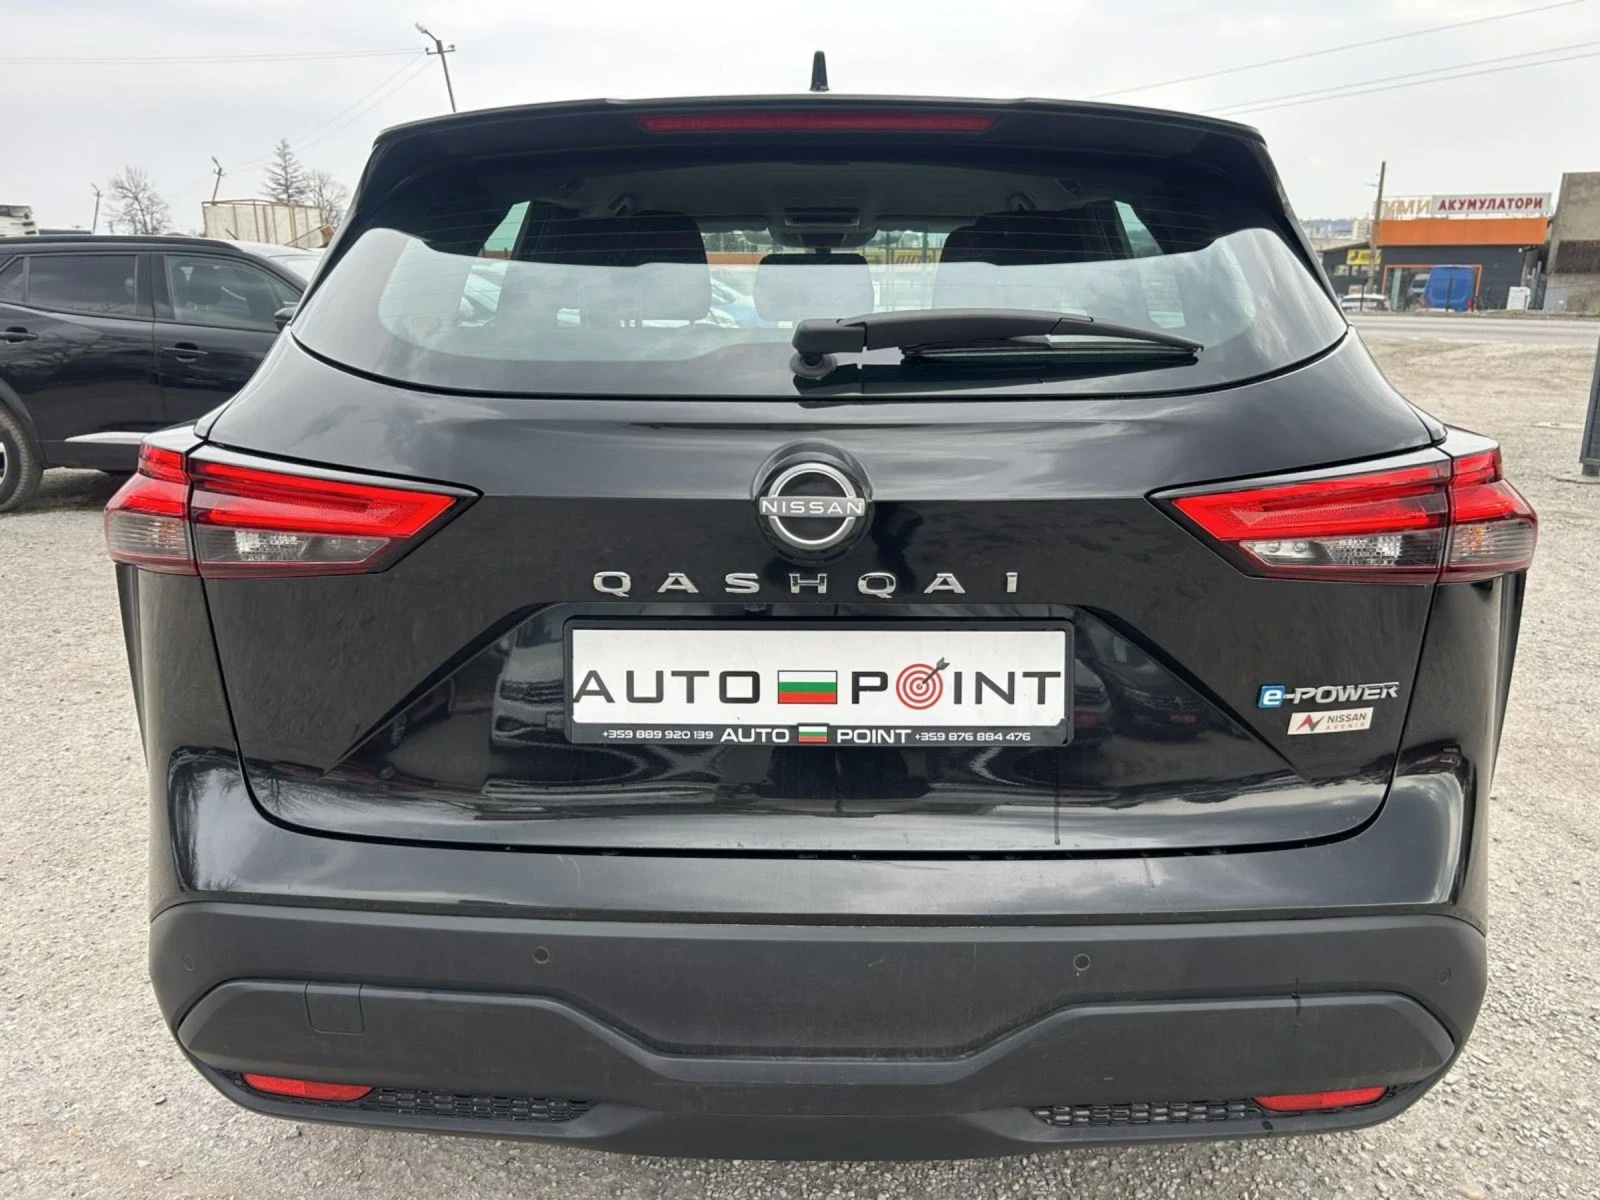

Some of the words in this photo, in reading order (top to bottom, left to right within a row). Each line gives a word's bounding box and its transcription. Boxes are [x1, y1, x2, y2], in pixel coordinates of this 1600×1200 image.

[1438, 197, 1543, 211] АКУМУЛАТОРИ
[762, 500, 863, 515] NISSAN
[593, 571, 1018, 598] QASHQAI
[573, 670, 760, 704] AUTO
[1261, 682, 1399, 707] e-POWER
[1327, 712, 1367, 724] NISSAN
[602, 729, 633, 739] +359
[636, 729, 662, 739] 889
[665, 730, 690, 739] 920
[693, 730, 714, 740] 139
[720, 727, 790, 743] AUTO
[836, 729, 912, 744] POINT
[914, 732, 945, 741] +359
[948, 732, 974, 741] 876
[976, 732, 1003, 741] 884
[1005, 732, 1031, 741] 476
